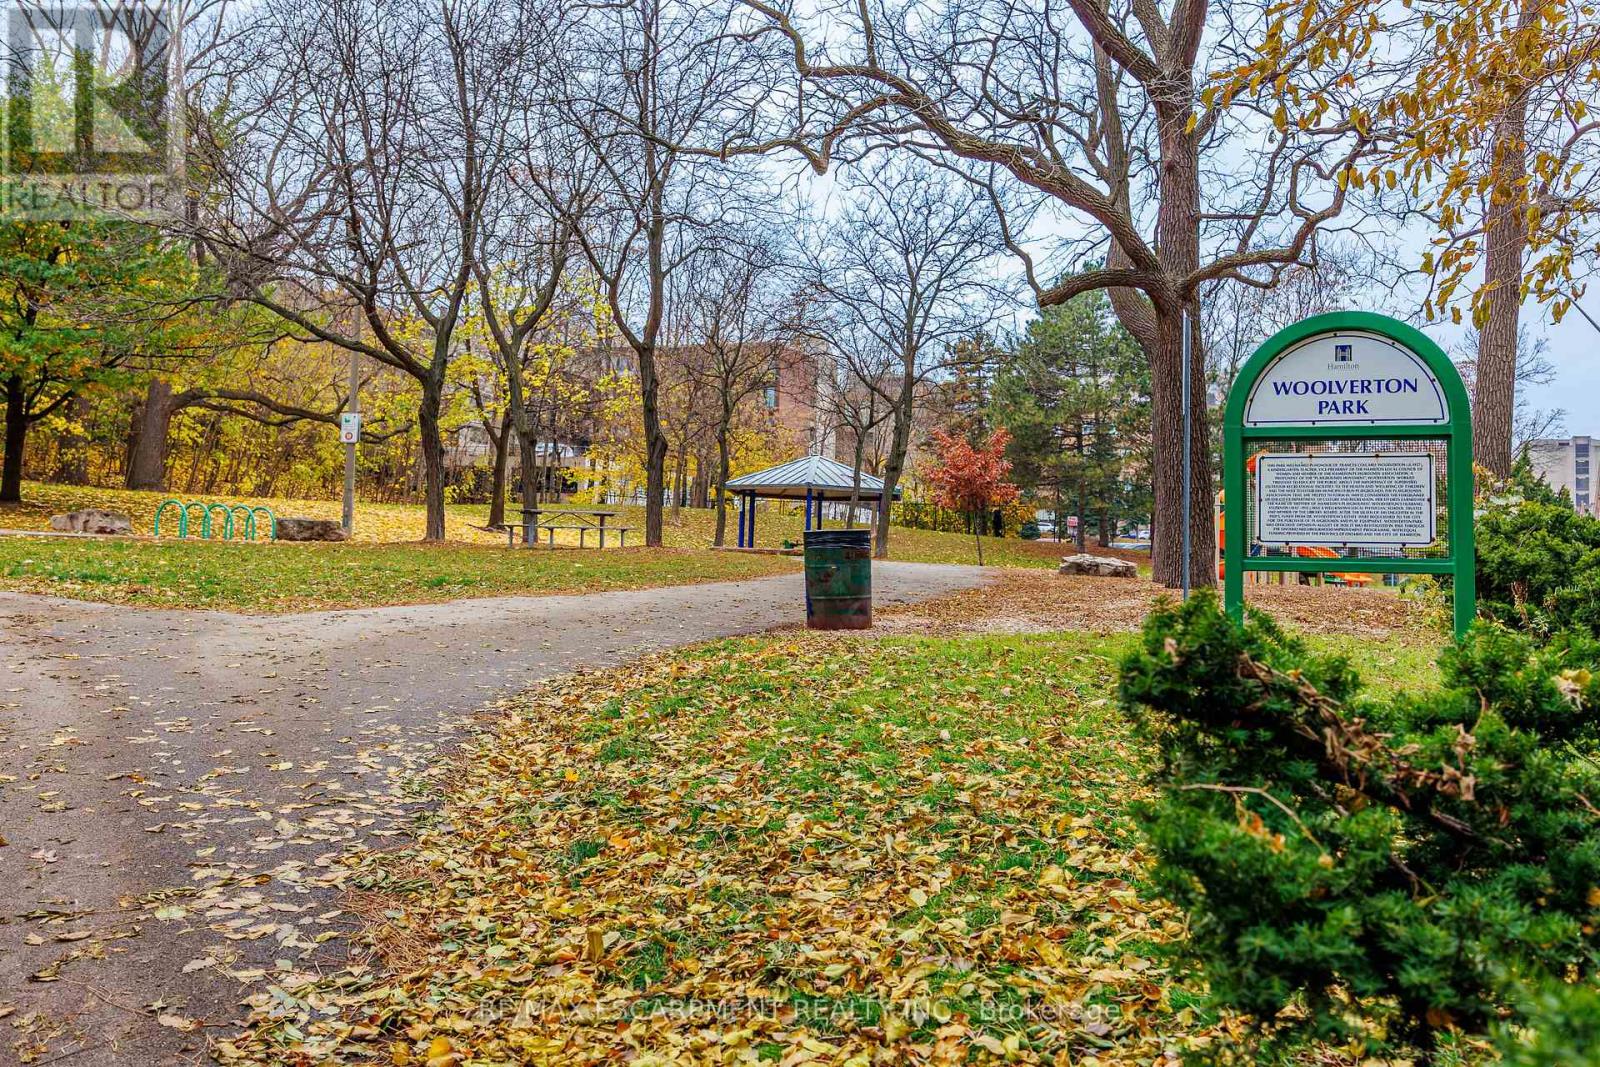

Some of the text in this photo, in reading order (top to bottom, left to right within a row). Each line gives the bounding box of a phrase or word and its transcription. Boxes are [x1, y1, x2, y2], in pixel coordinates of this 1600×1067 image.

[1327, 362, 1360, 371] Hamilton
[1273, 378, 1418, 395] WOOLVERTON
[1318, 400, 1369, 415] PARK
